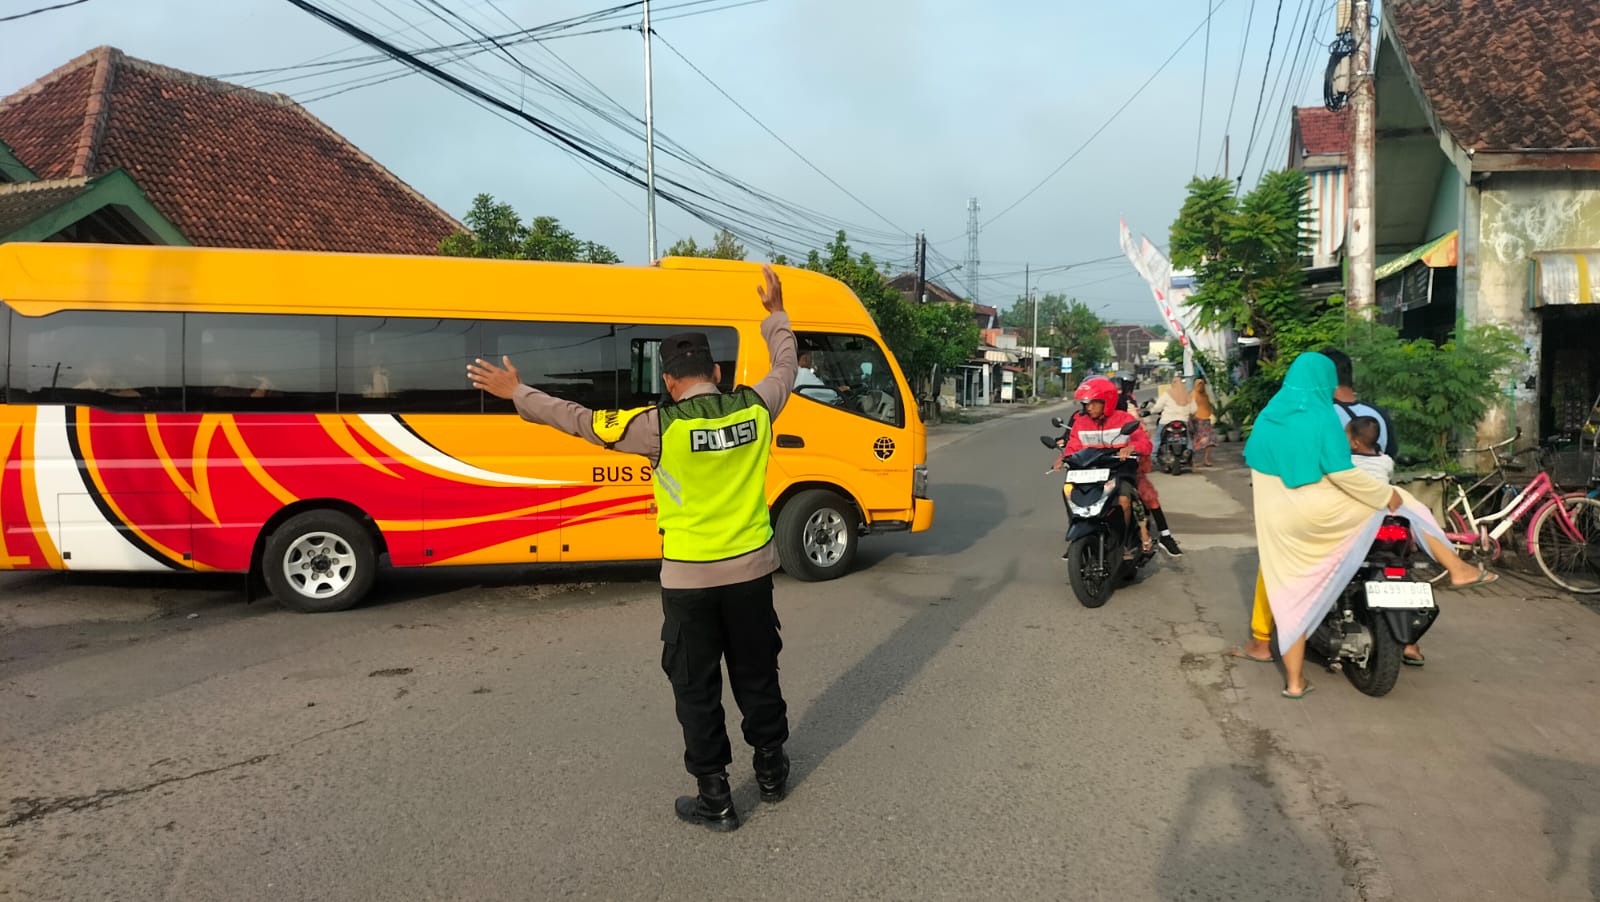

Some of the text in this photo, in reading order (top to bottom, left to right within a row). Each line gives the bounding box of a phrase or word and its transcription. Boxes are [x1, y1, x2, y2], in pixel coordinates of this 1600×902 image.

[692, 420, 756, 450] POLISI
[592, 466, 652, 483] BUS S
[1368, 584, 1380, 594] AD
